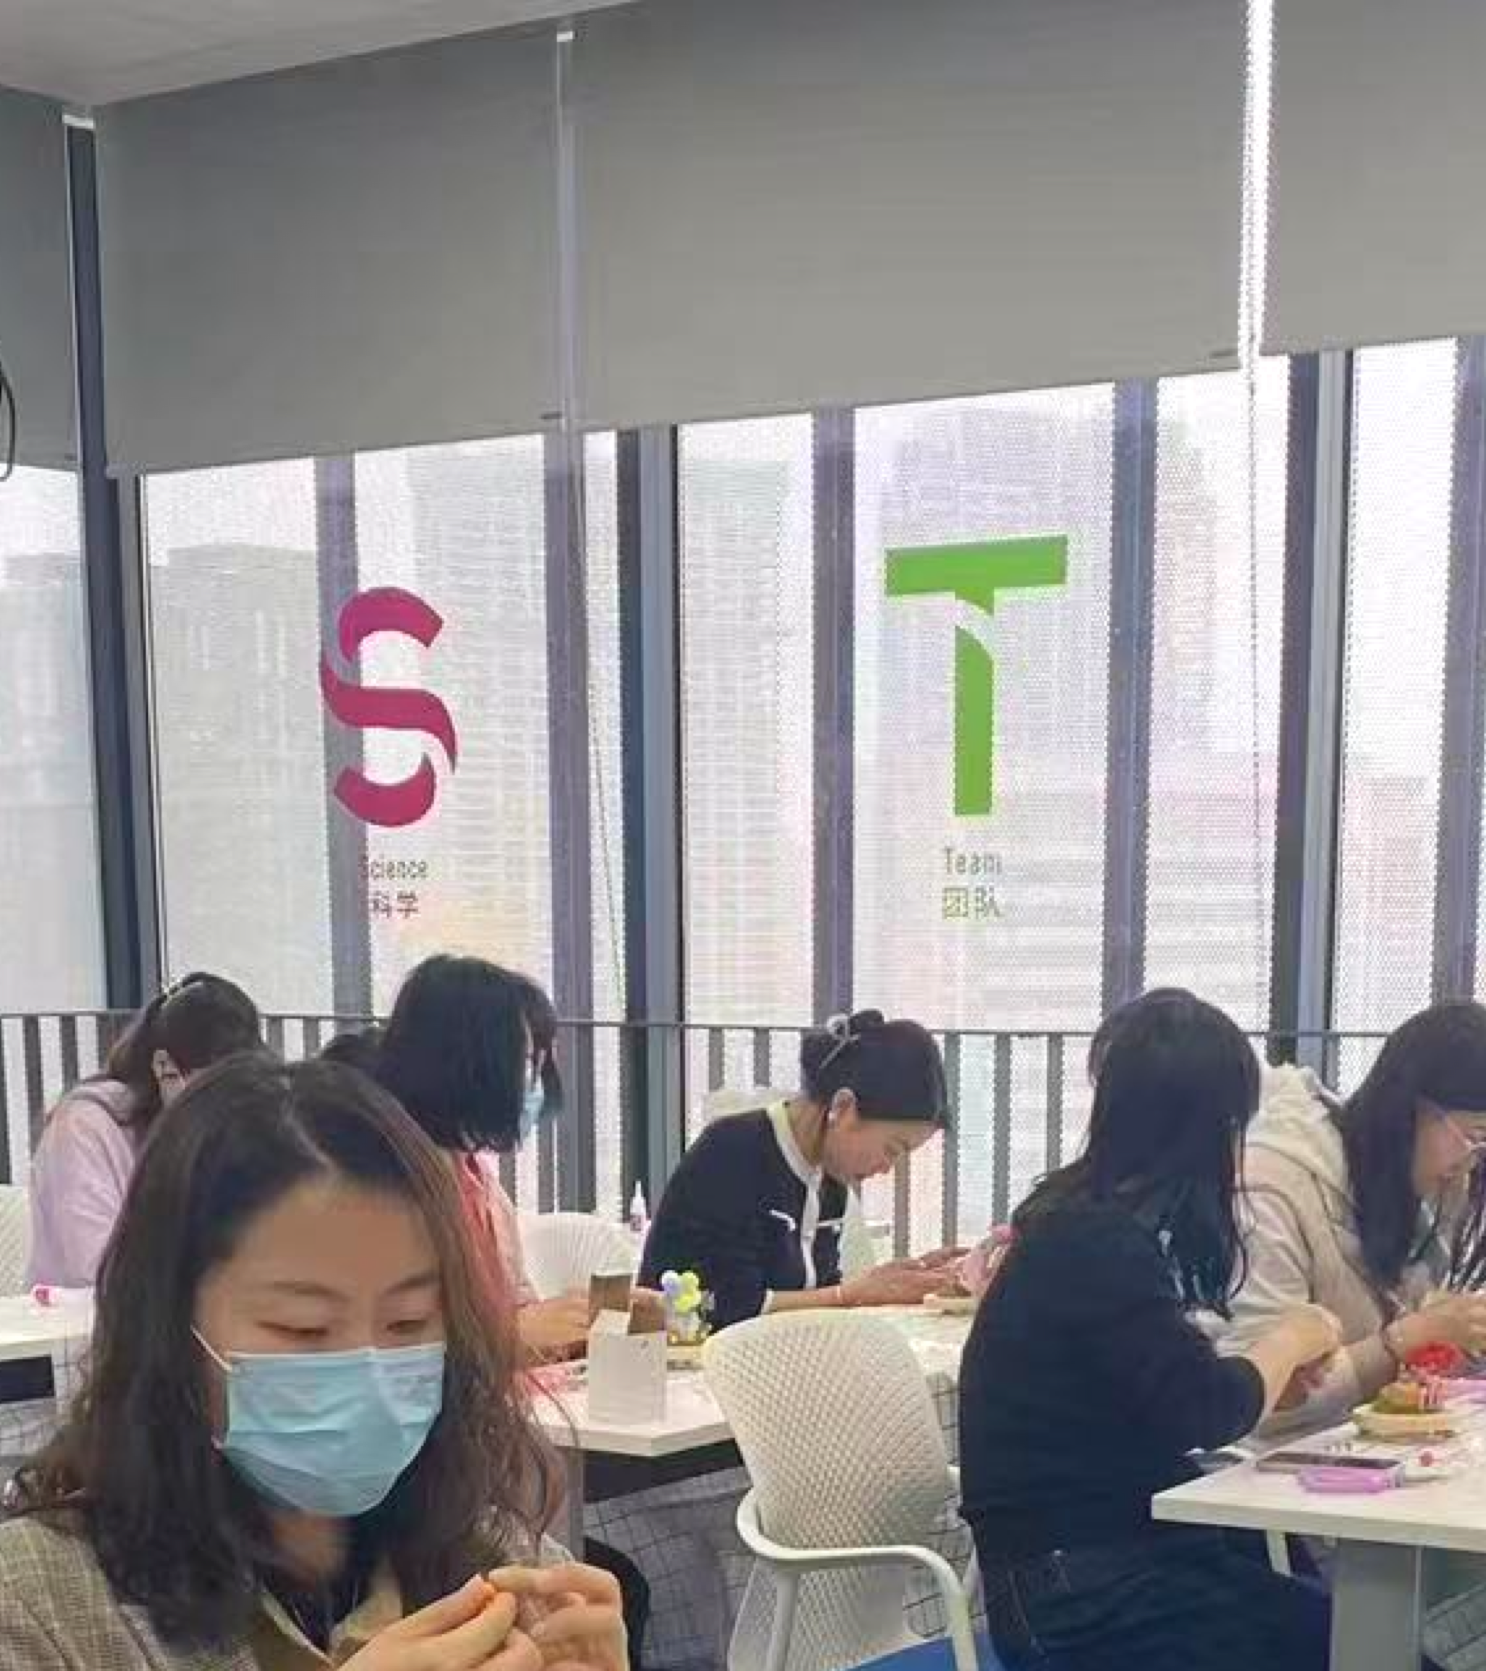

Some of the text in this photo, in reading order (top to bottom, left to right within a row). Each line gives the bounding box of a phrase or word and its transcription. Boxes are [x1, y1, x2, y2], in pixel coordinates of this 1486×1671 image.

[886, 534, 1067, 816] T
[320, 587, 457, 827] S
[358, 854, 427, 880] Science
[940, 845, 1003, 875] Team
[369, 890, 419, 918] 科学
[942, 885, 1003, 919] 团队
